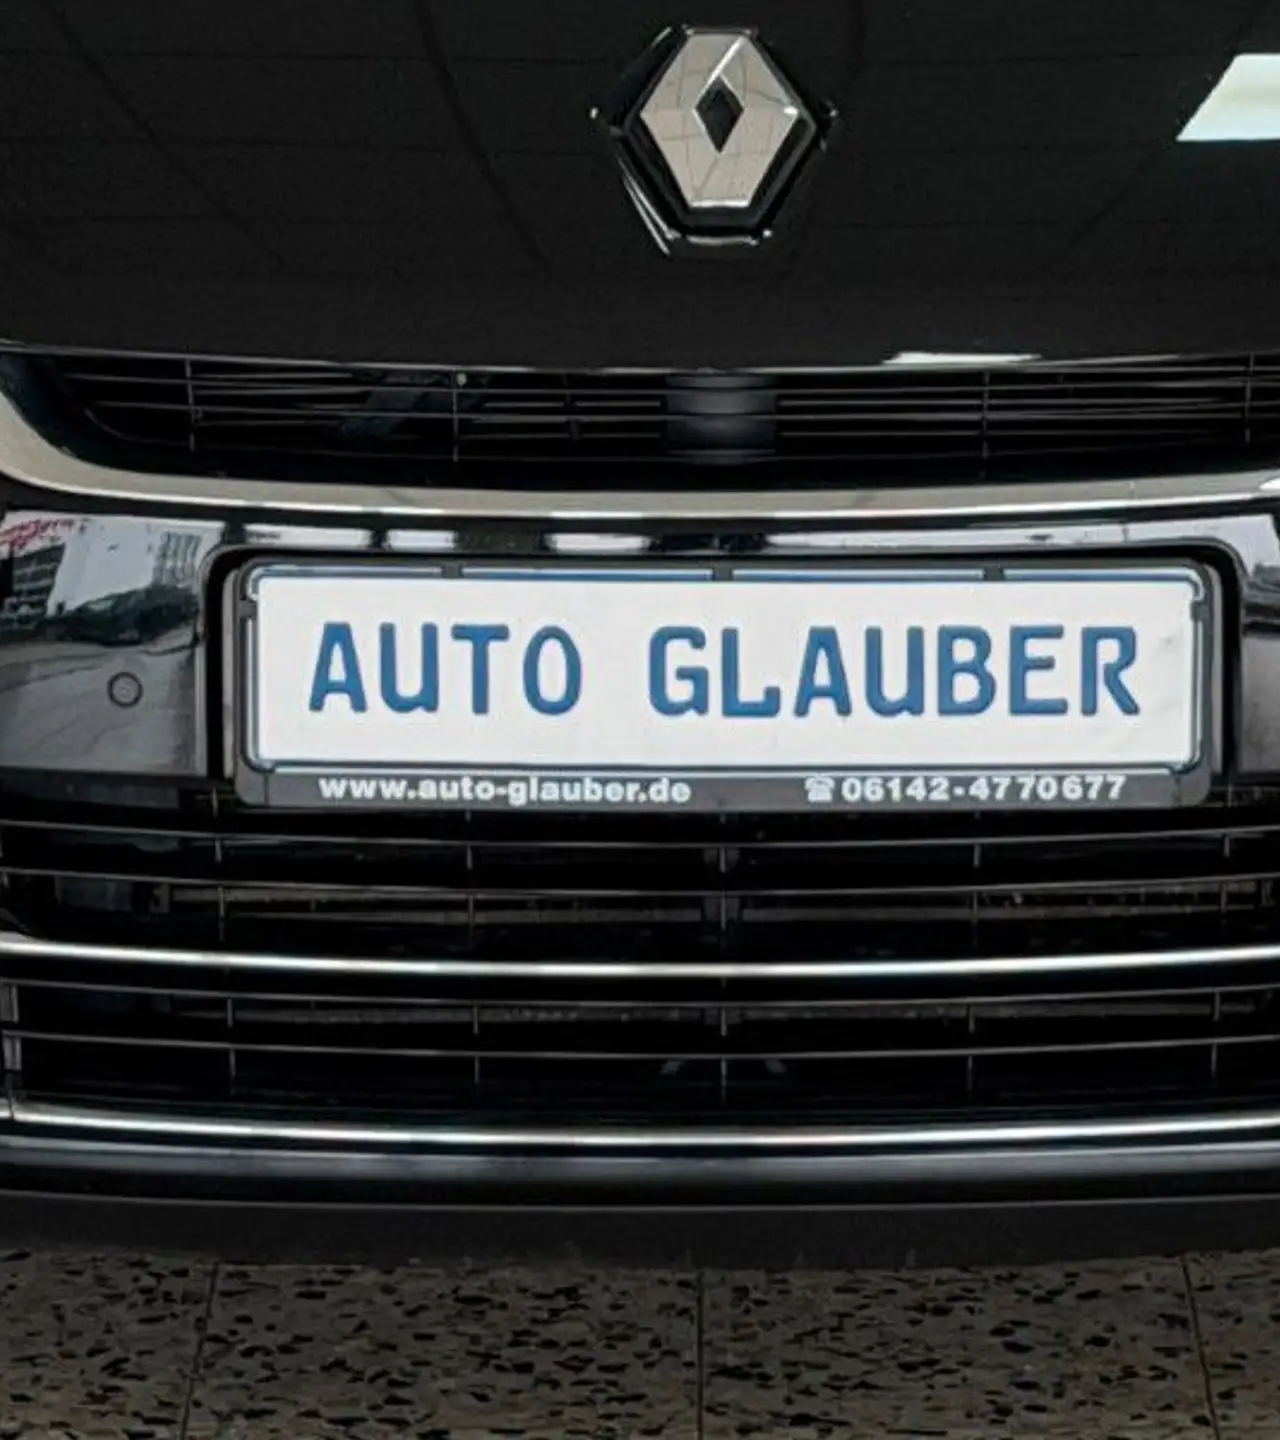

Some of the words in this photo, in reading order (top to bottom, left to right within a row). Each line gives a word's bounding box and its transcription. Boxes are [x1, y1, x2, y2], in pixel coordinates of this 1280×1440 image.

[309, 621, 583, 717] AUTO
[648, 625, 1140, 719] GLAUBER
[317, 775, 693, 807] www.auto-glauber.de
[841, 774, 1127, 803] 06142-4770677
